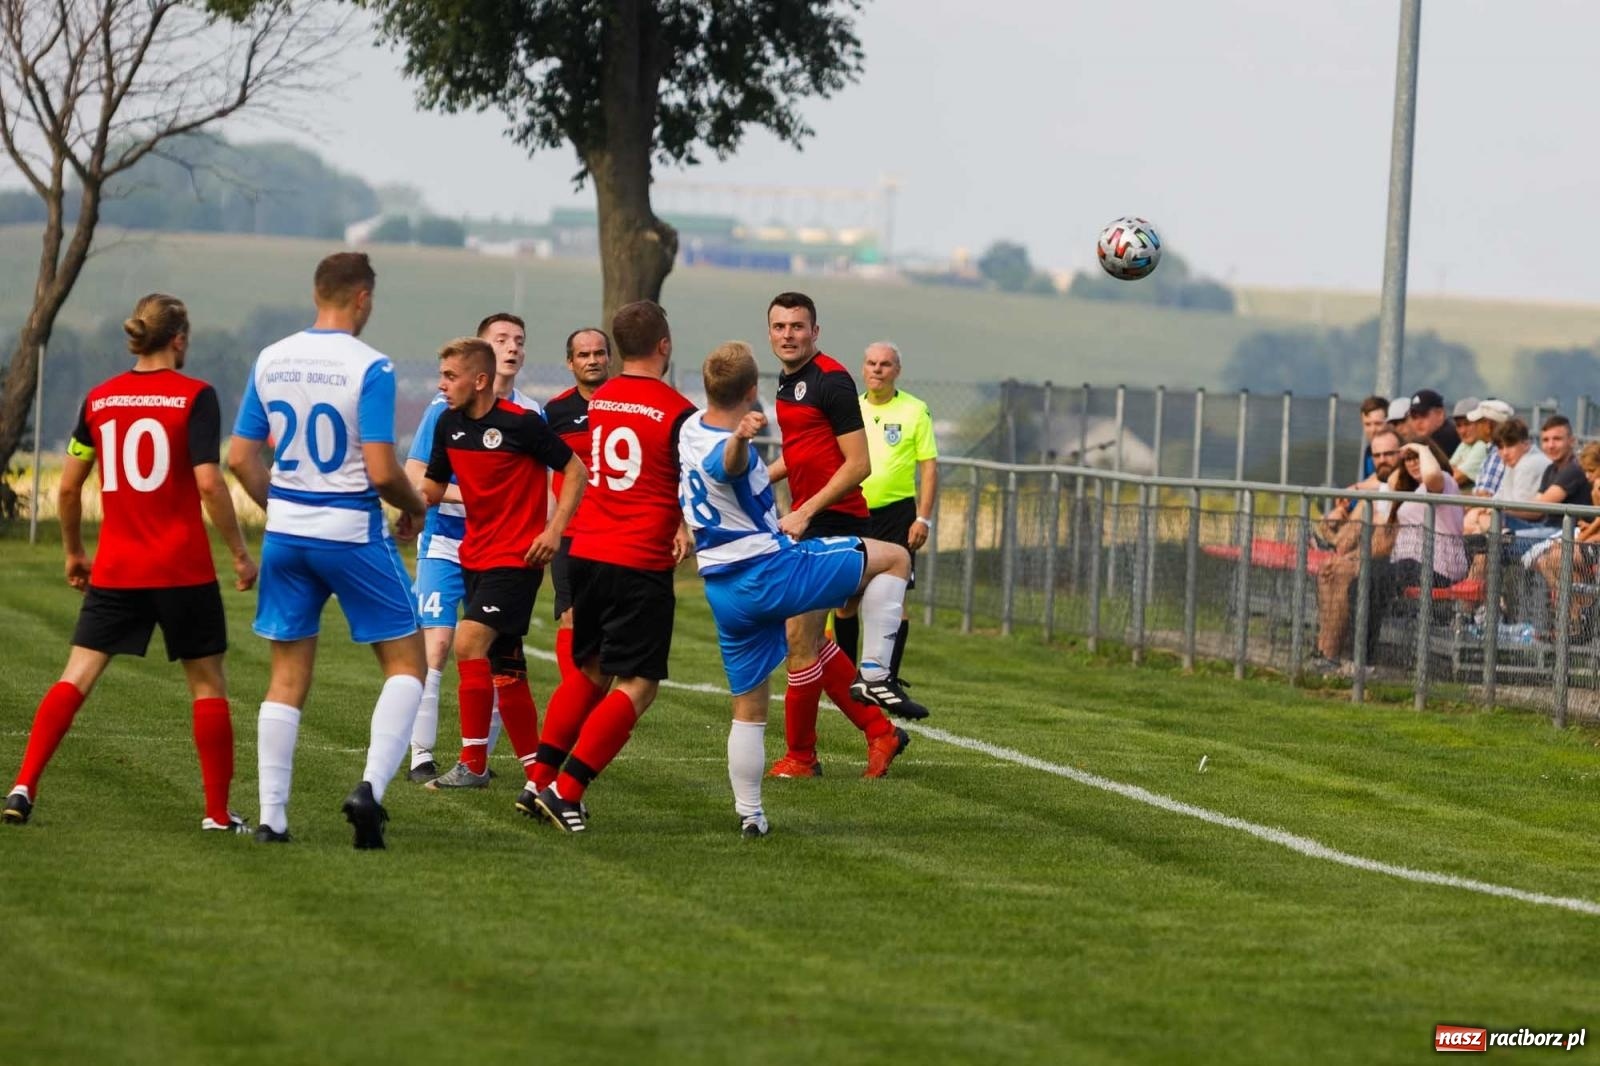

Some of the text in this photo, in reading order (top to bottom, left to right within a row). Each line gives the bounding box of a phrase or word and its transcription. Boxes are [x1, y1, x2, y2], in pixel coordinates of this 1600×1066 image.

[106, 394, 188, 409] GRZEGORZOWICE
[266, 400, 348, 474] 20
[99, 417, 170, 492] 10
[588, 424, 643, 492] 19
